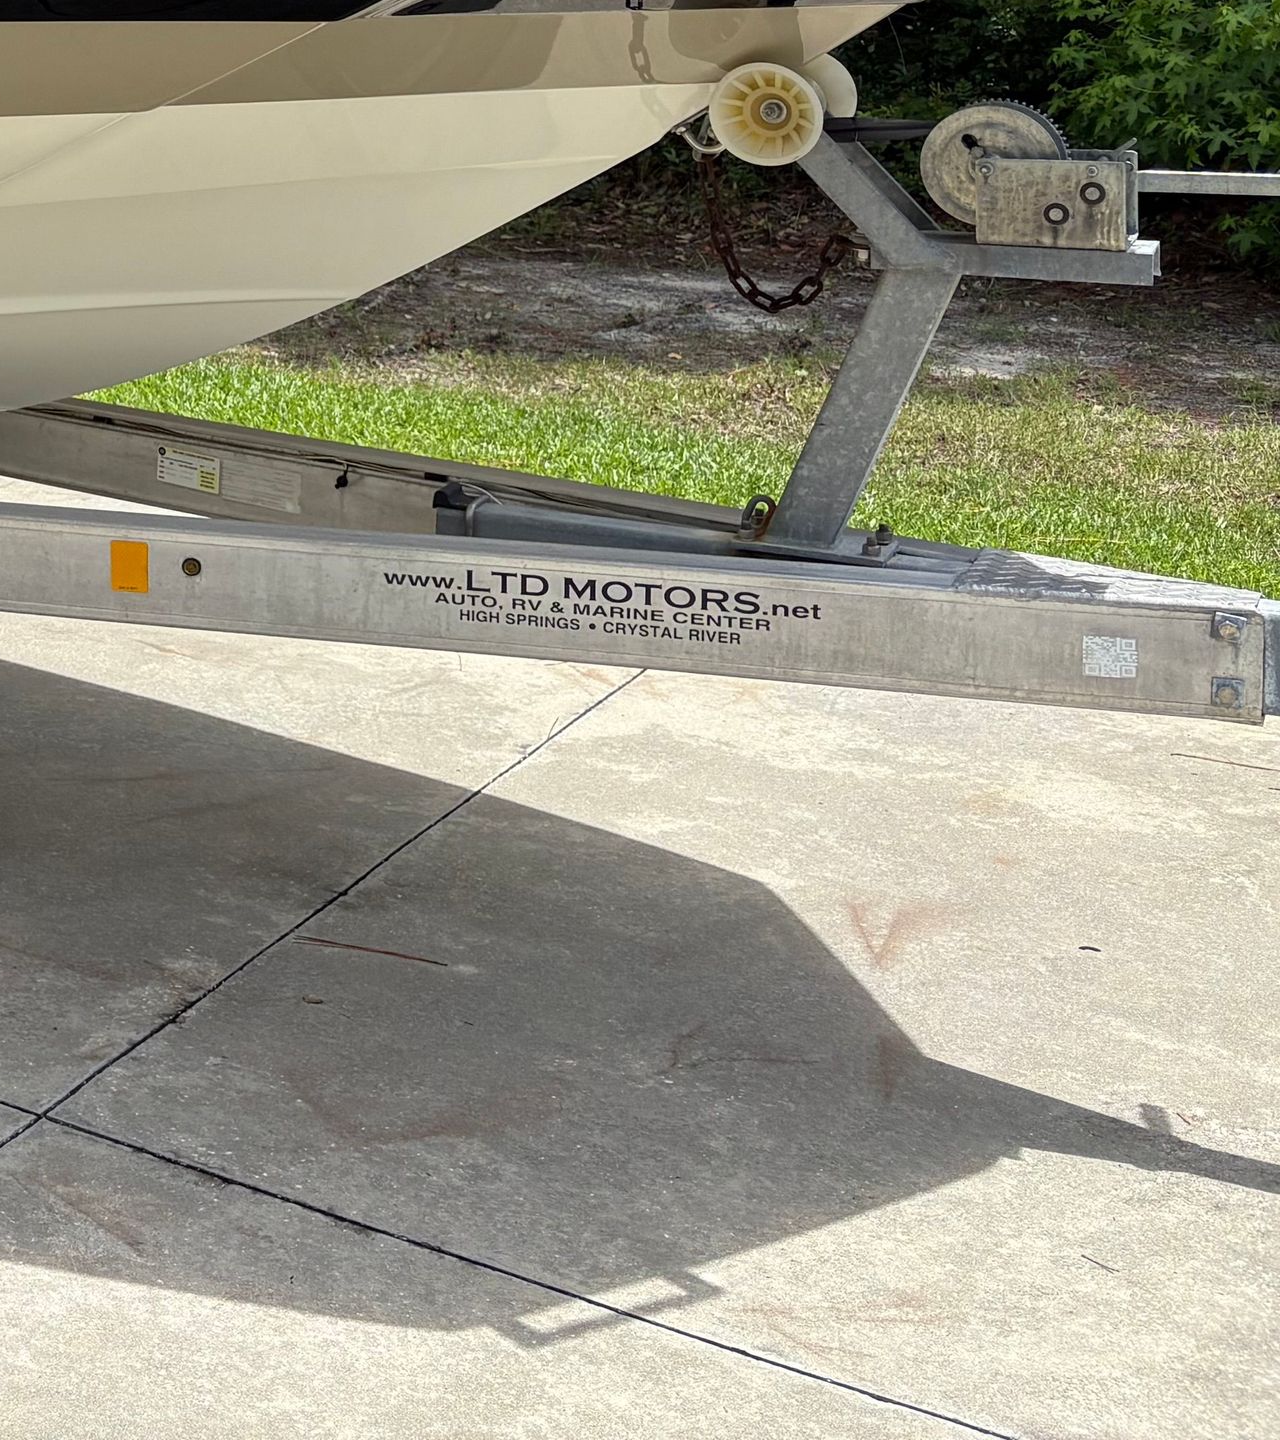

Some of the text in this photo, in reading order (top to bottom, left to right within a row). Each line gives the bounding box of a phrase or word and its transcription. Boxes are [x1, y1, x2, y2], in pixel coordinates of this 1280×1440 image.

[383, 569, 821, 620] www.LTD MOTORS.net
[435, 592, 771, 632] AUTO, RV & MARINE CENTER
[459, 609, 741, 645] HIGH SPRINGS CRYSTAL RIVER
